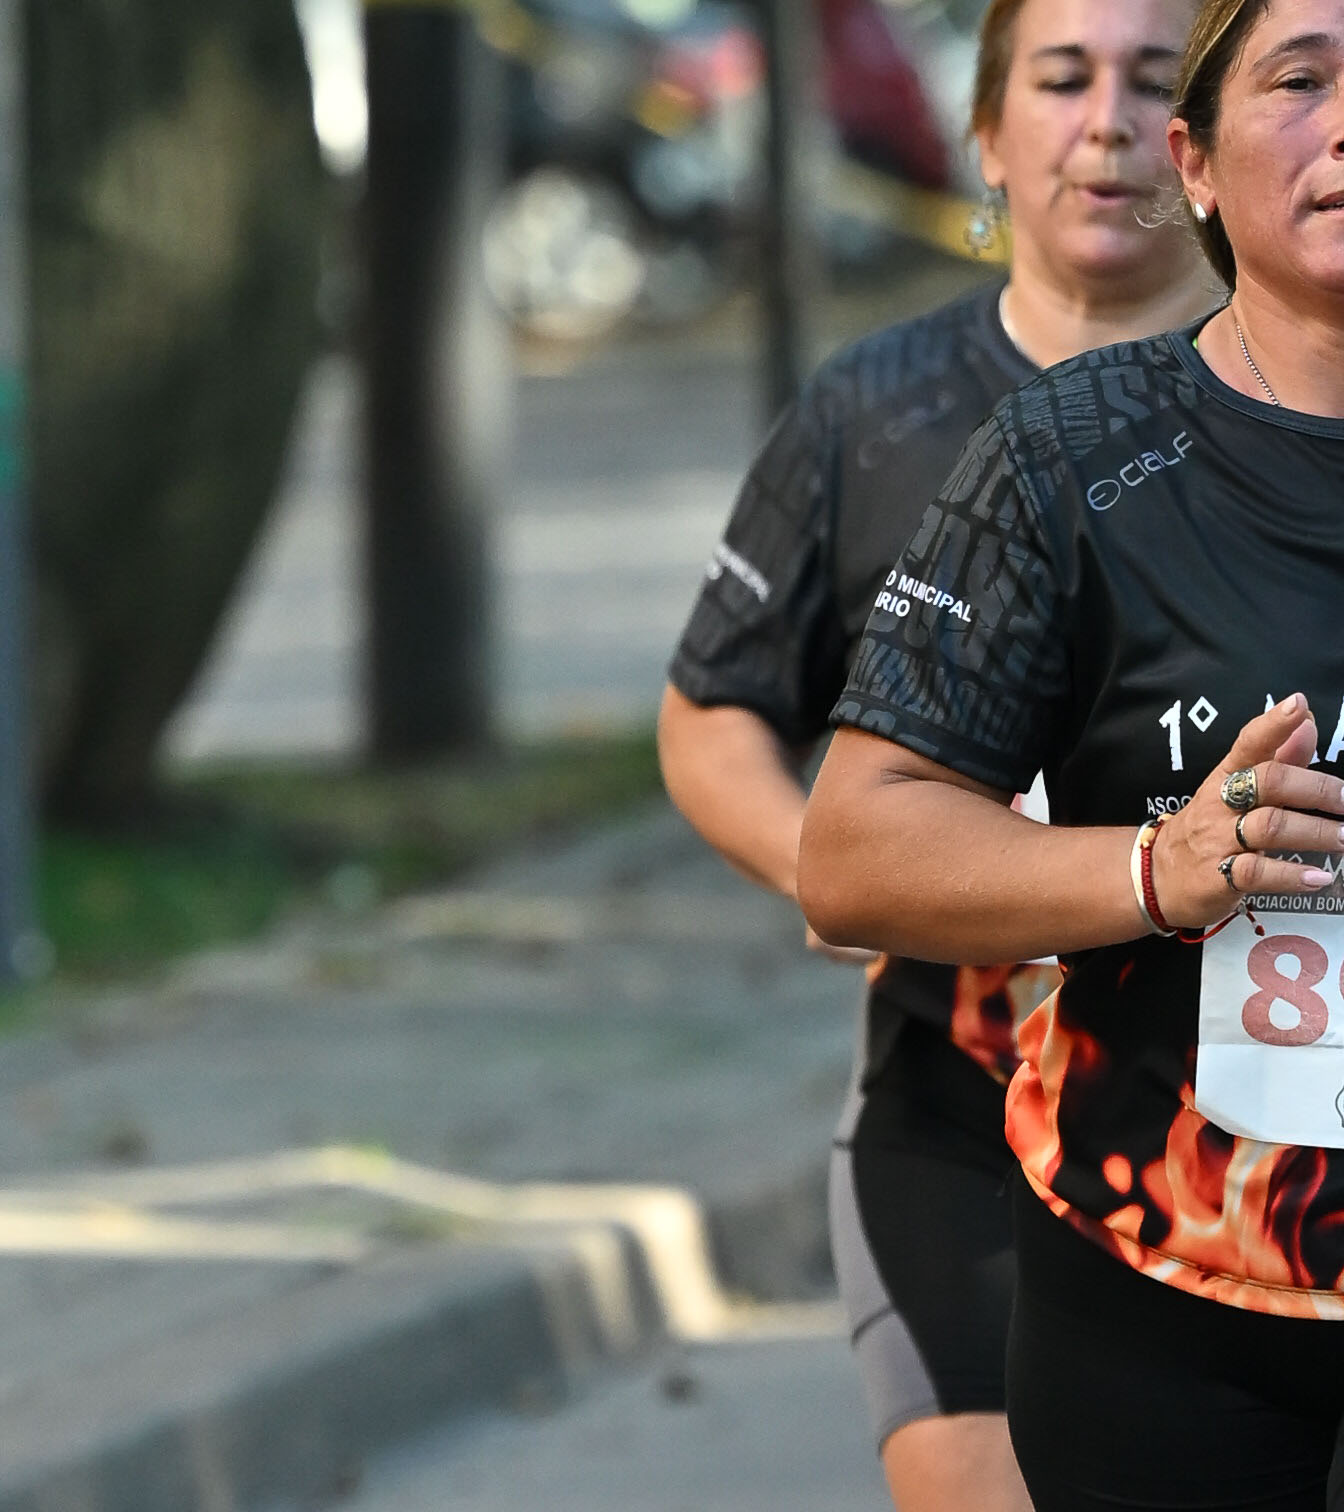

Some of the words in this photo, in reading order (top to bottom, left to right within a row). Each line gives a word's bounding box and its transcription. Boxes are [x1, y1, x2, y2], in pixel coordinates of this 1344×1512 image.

[874, 590, 911, 618] RIO
[897, 574, 973, 624] MUCIPAL
[1146, 795, 1194, 816] ASOC
[1242, 934, 1344, 1047] 8
